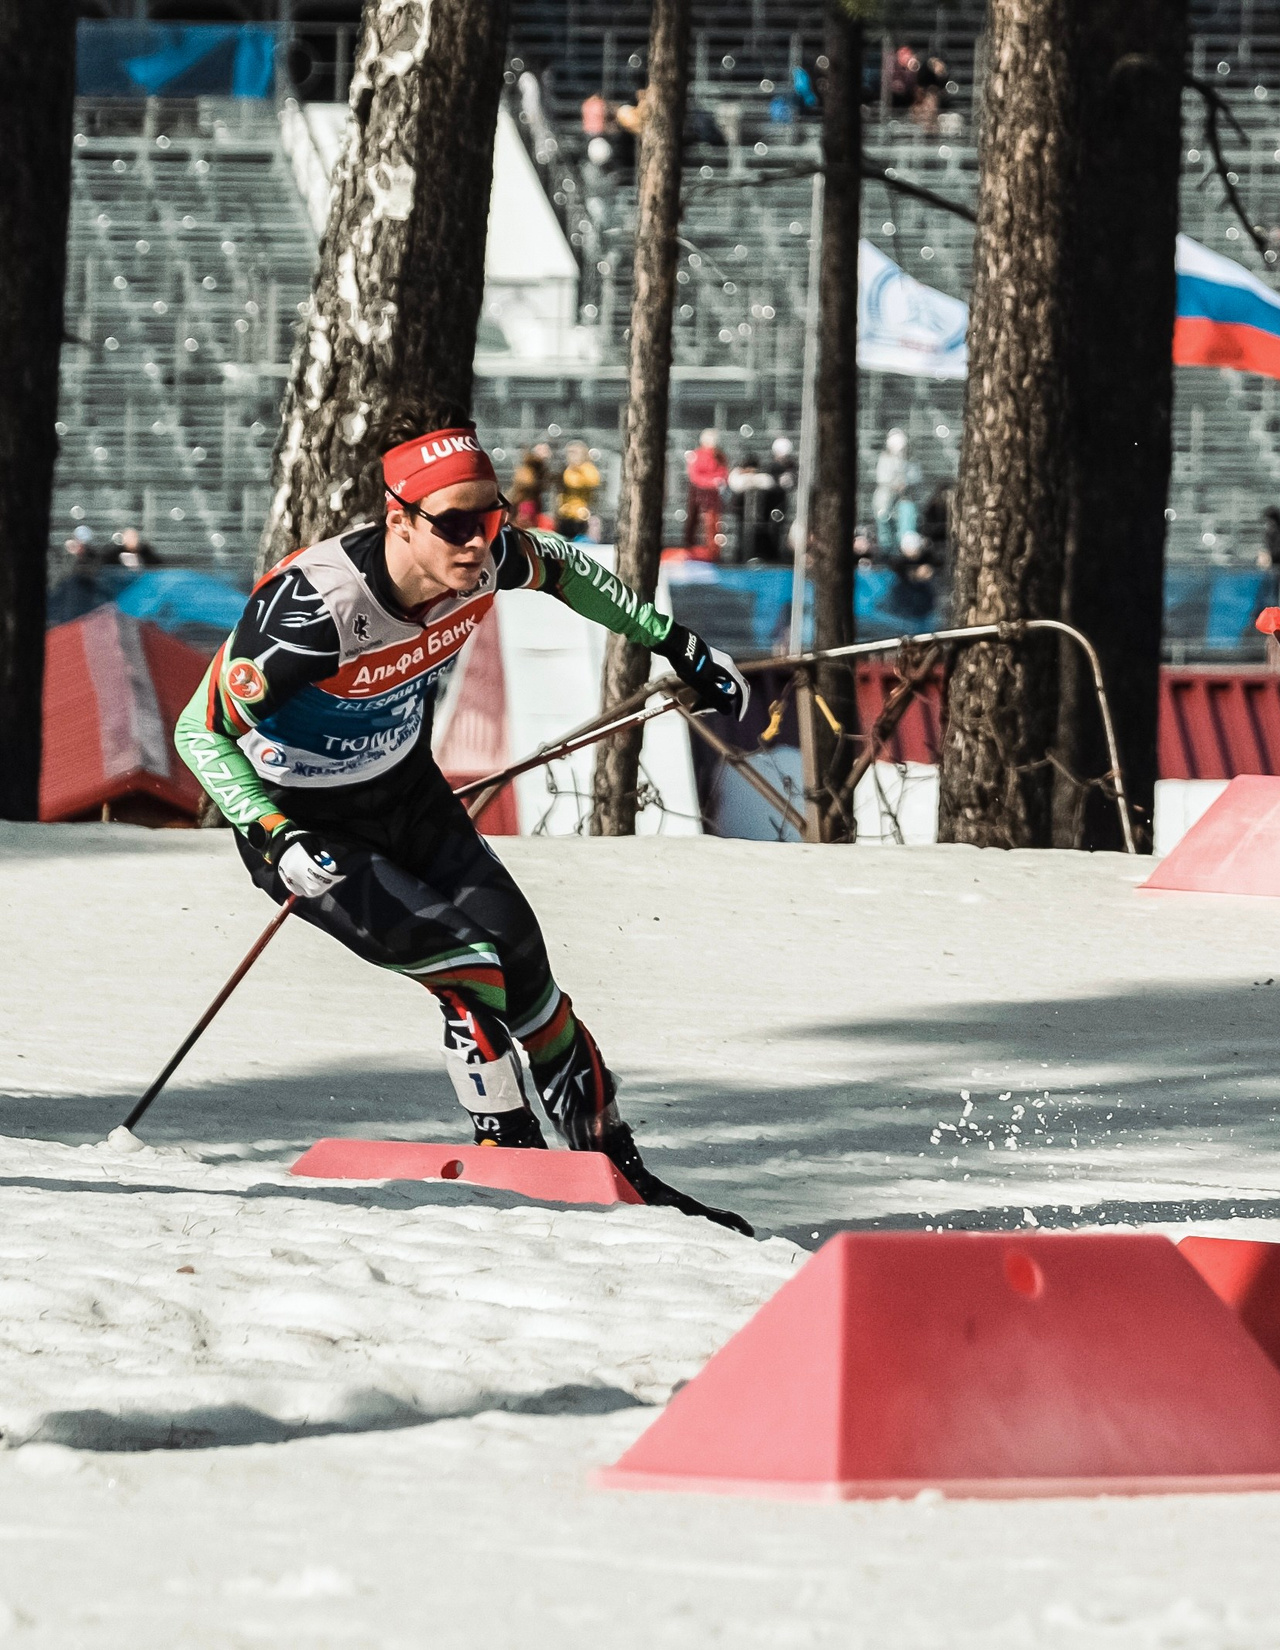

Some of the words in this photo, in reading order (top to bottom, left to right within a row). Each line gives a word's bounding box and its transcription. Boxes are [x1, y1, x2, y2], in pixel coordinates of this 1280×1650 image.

[348, 646, 424, 694] Альфа
[427, 613, 479, 656] Банк
[186, 731, 261, 823] KAZAN
